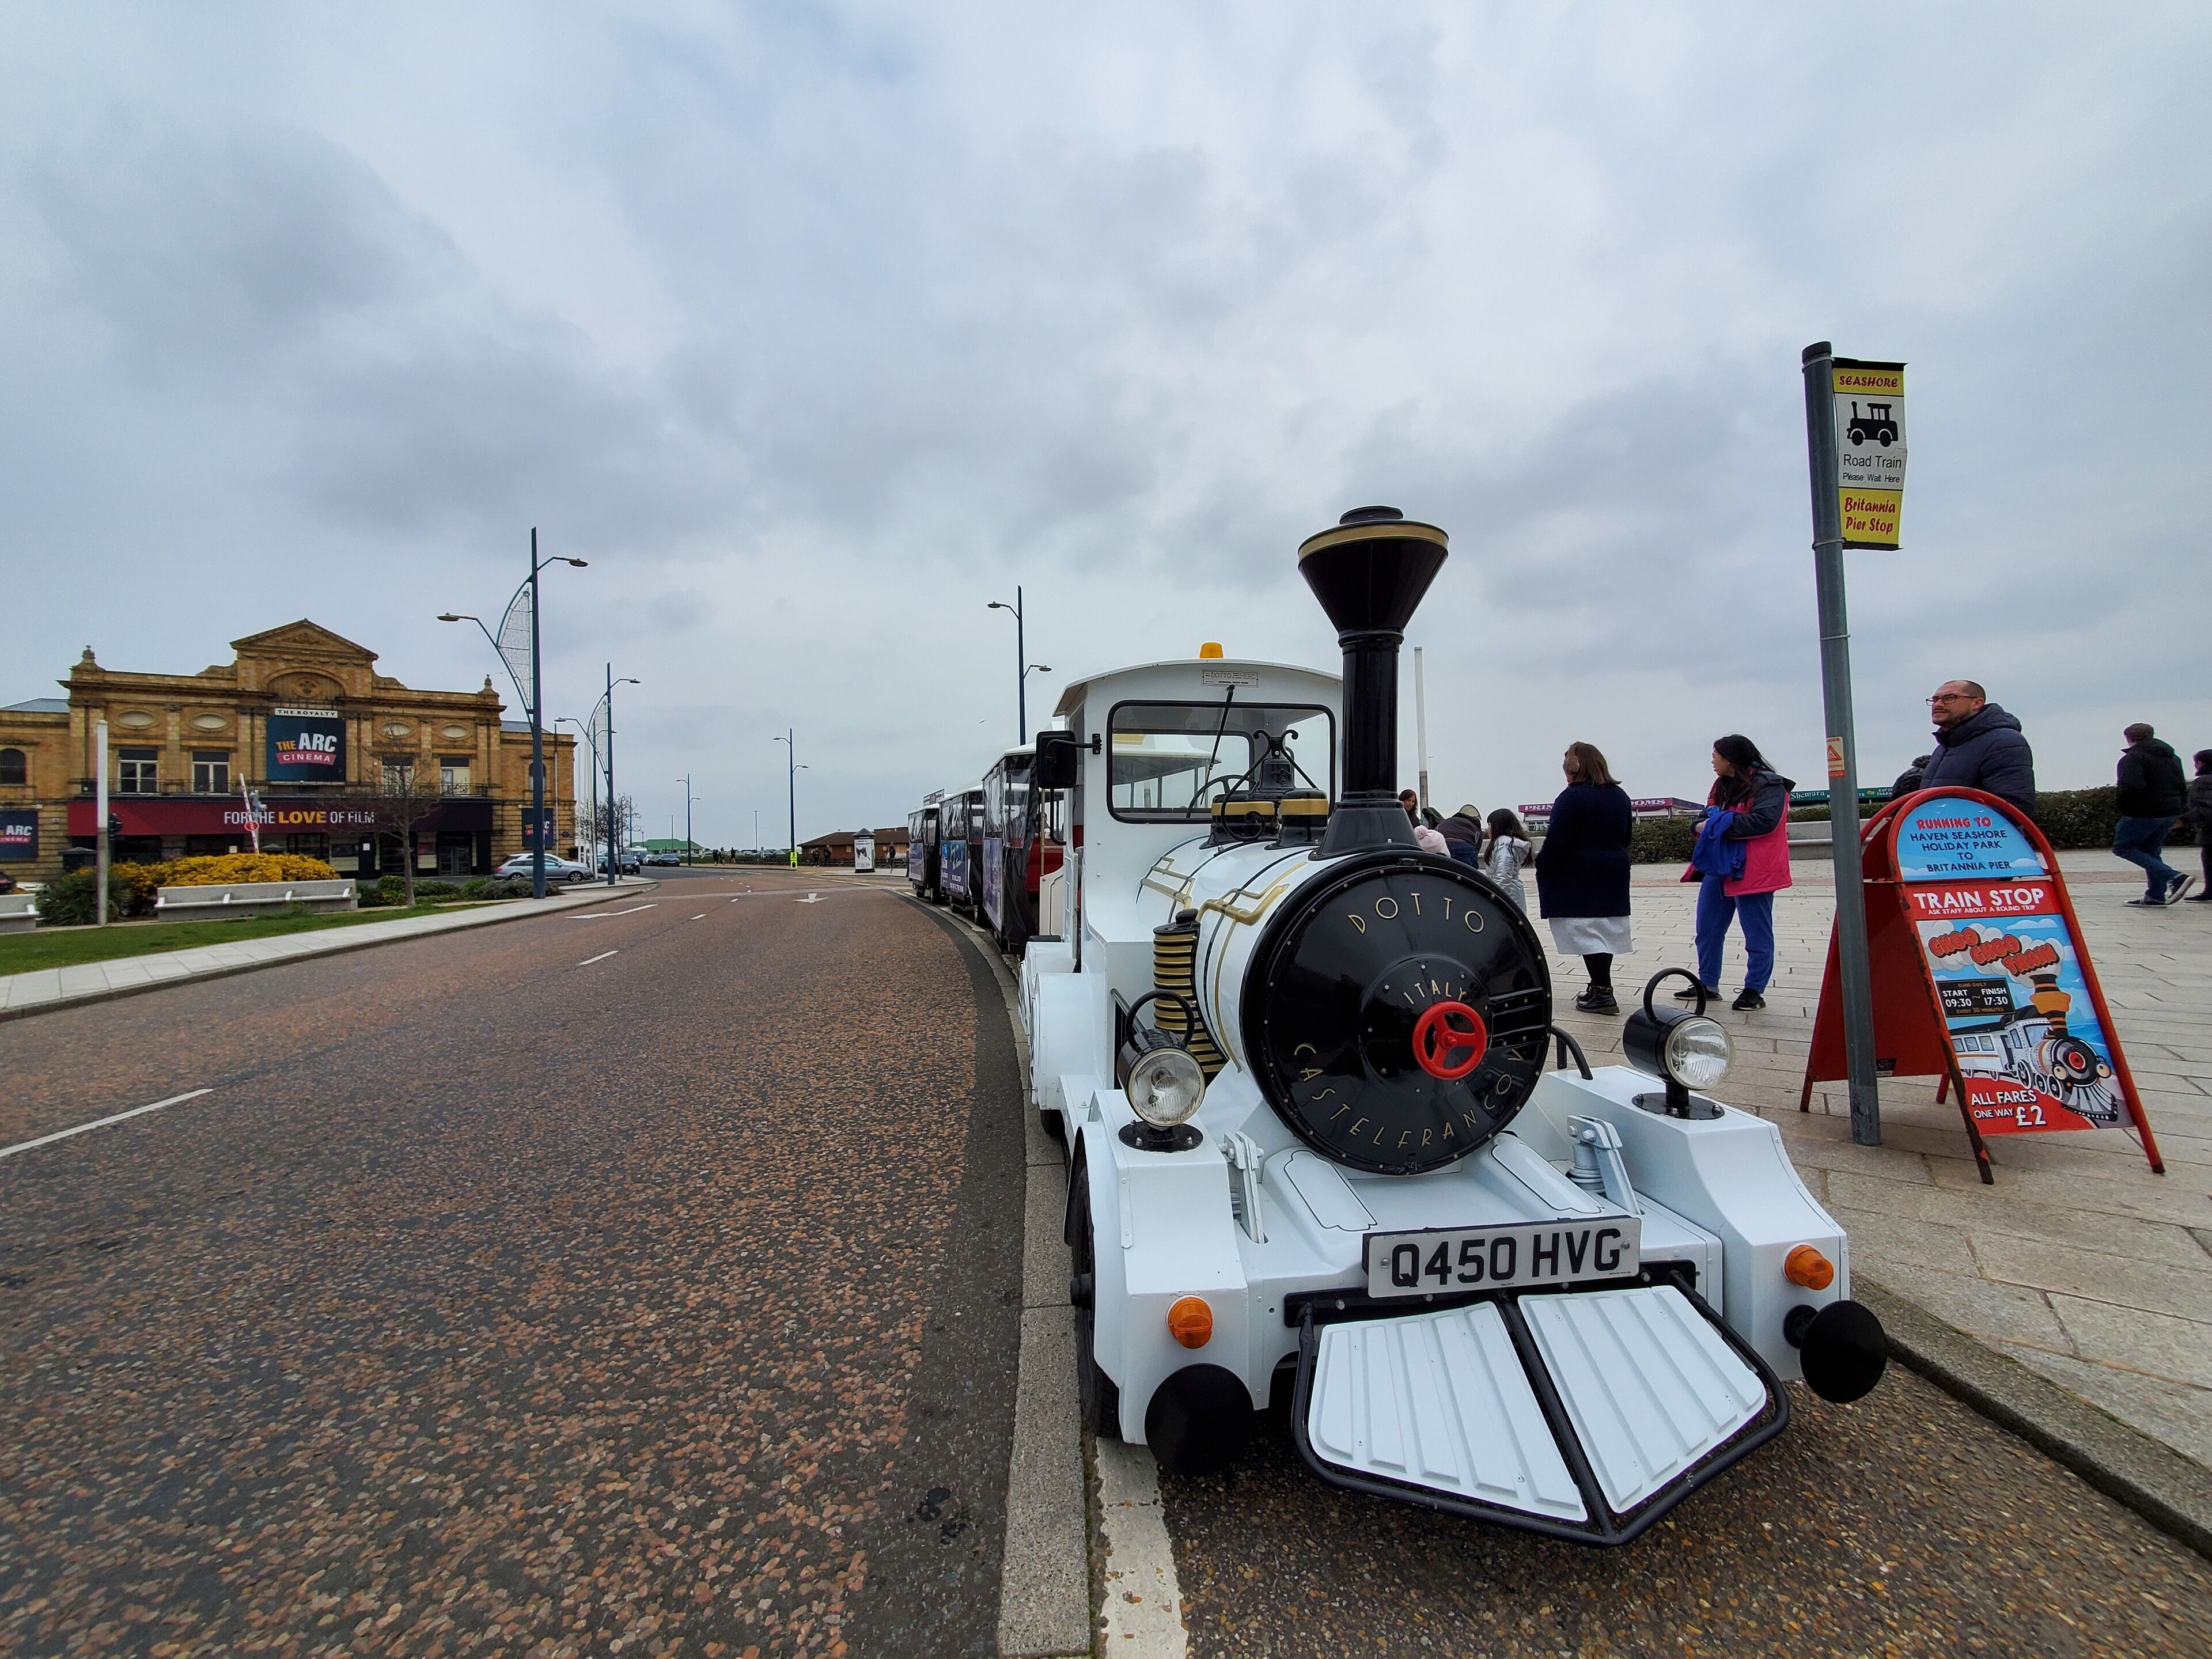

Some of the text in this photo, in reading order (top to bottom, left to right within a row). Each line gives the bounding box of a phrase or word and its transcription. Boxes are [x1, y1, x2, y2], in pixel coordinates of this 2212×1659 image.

[1839, 375, 1899, 388] SEASHORE
[1843, 453, 1902, 469] Road Train
[1842, 472, 1900, 483] Please Wait Here
[1844, 497, 1896, 514] Britannia
[1845, 516, 1893, 535] Pier Stop
[275, 733, 338, 752] THE ARC
[283, 753, 331, 762] CINEMA
[224, 811, 374, 824] FOR HE LOVE OF FILM
[1916, 816, 1992, 830] RUNNING TO
[6, 825, 33, 836] ARC
[1910, 830, 2008, 842] HAVEN SEASHORE
[1922, 840, 2003, 851] HOLIDAY PARK
[1957, 851, 1974, 861] TO
[1926, 861, 2012, 872] BRITANNIA PIER
[1913, 888, 2044, 909] TRAIN STOP
[1347, 892, 1485, 935] DOTTO
[2000, 942, 2060, 977] TRAIN
[1403, 979, 1467, 1005] ITALY
[1942, 987, 2008, 997] START FINISH
[1945, 996, 2008, 1008] 09:30 17:30
[1971, 1089, 2037, 1105] ALL FARES
[1974, 1105, 2047, 1126] ONE WAY £2
[1391, 1228, 1622, 1288] Q450 HVG
